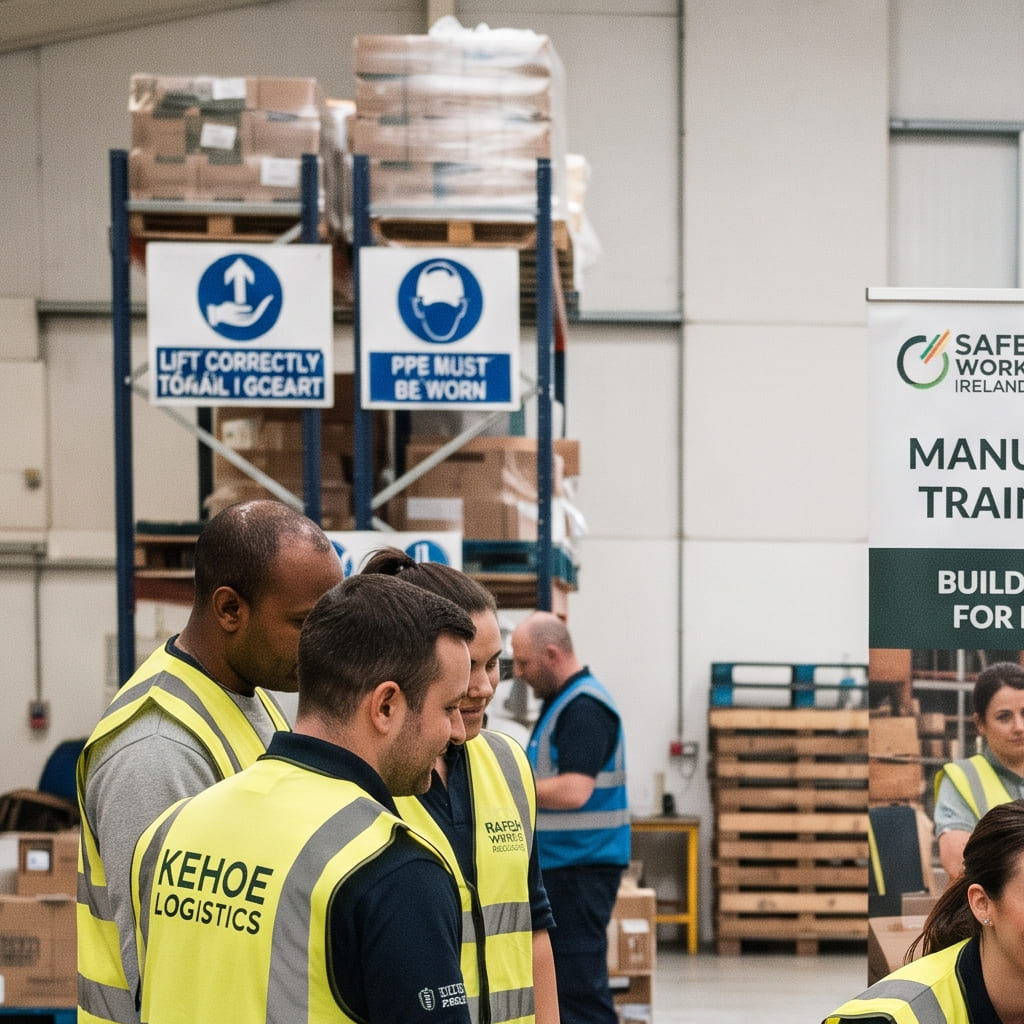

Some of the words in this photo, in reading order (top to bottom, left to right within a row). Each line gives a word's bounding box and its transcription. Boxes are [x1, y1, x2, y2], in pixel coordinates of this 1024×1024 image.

[159, 350, 203, 372] LIFT
[205, 351, 321, 373] CORRECTLY
[391, 355, 430, 377] PPE
[433, 355, 489, 377] MUST
[243, 376, 324, 397] GCEART
[394, 379, 422, 400] BE
[425, 379, 487, 400] WORN
[953, 604, 1013, 630] FOR
[158, 849, 274, 905] KEHOE
[154, 892, 262, 935] LOGISTICS
